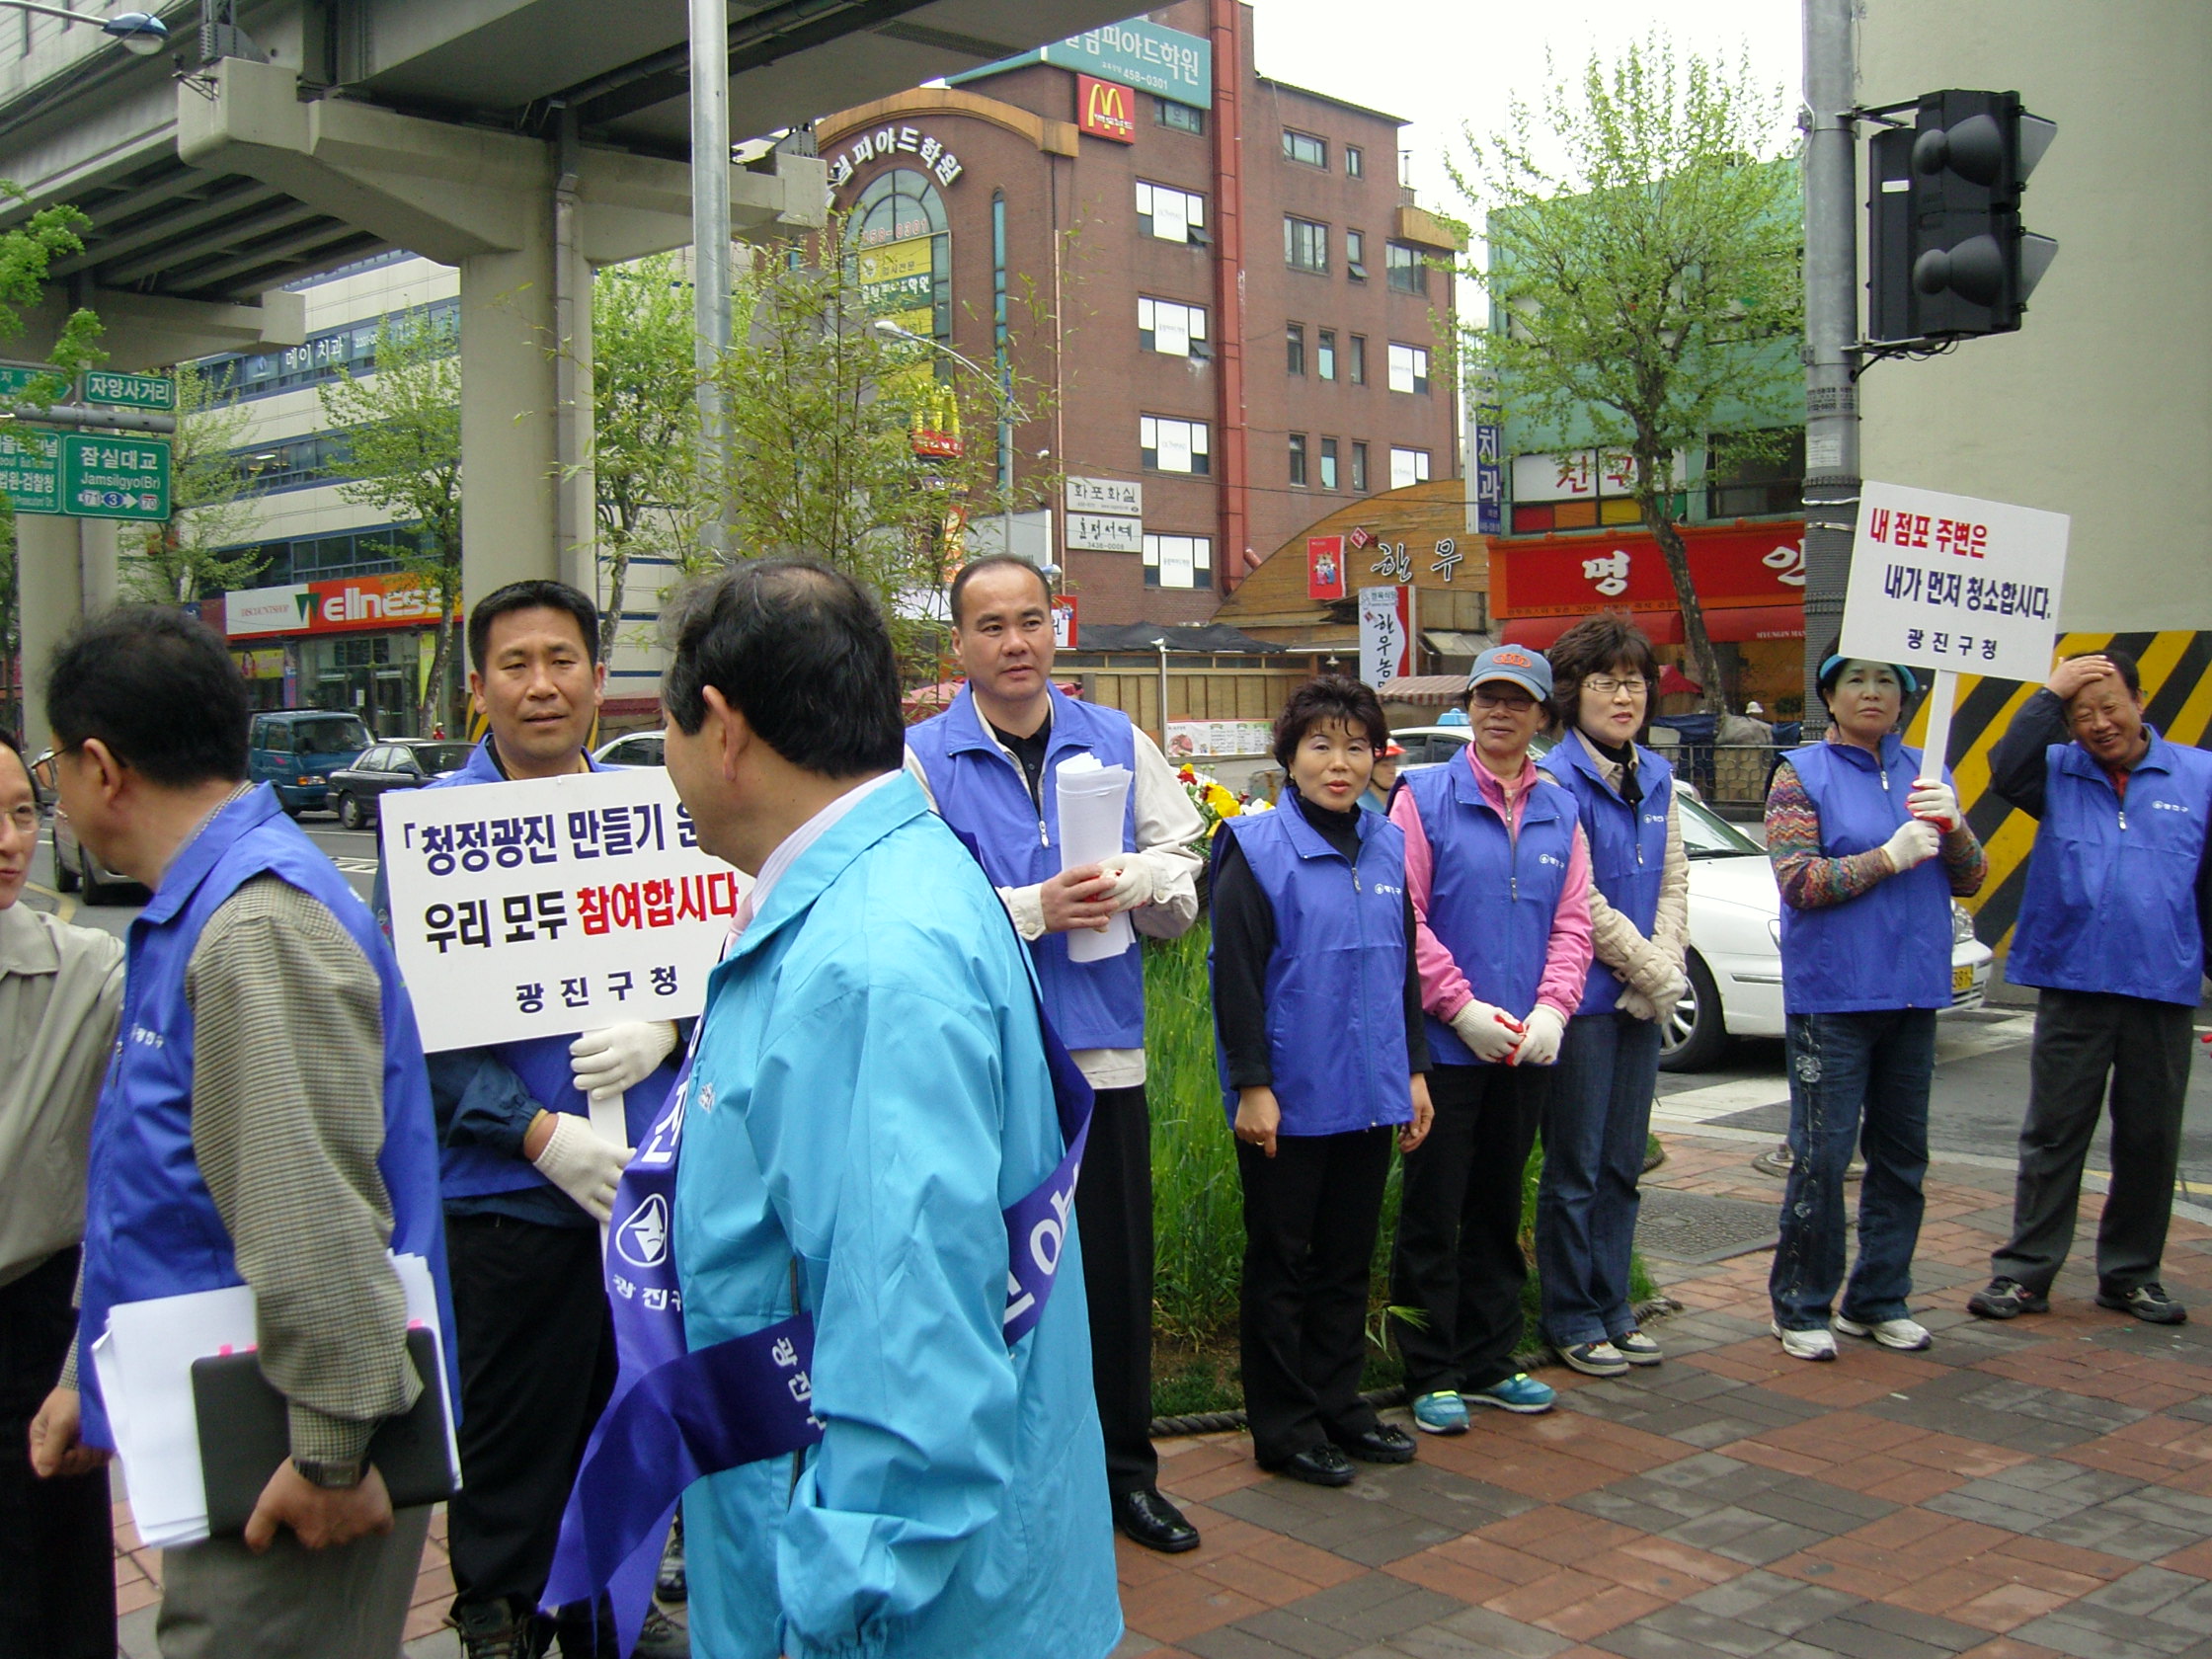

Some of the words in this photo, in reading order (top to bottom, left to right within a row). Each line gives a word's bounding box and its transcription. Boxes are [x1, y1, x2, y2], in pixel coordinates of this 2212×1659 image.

[1123, 66, 1168, 90] 458-0301
[317, 336, 343, 361] 치과
[91, 376, 170, 403] 자양사거리
[81, 446, 158, 470] 잠실대교
[81, 472, 161, 491] Jamsilgyo(Br)
[1869, 508, 1890, 543] 내
[1894, 512, 1931, 548] 점포
[1936, 518, 1988, 559] 주변은
[1582, 550, 1630, 595] 명
[1884, 564, 1922, 601] 내가
[1927, 570, 1962, 607] 먼저
[1966, 577, 2051, 620] 청소합시다.
[568, 803, 666, 860] 만들기
[425, 899, 492, 954] 우리
[503, 890, 568, 942] 모두
[577, 871, 739, 935] 참여합시다
